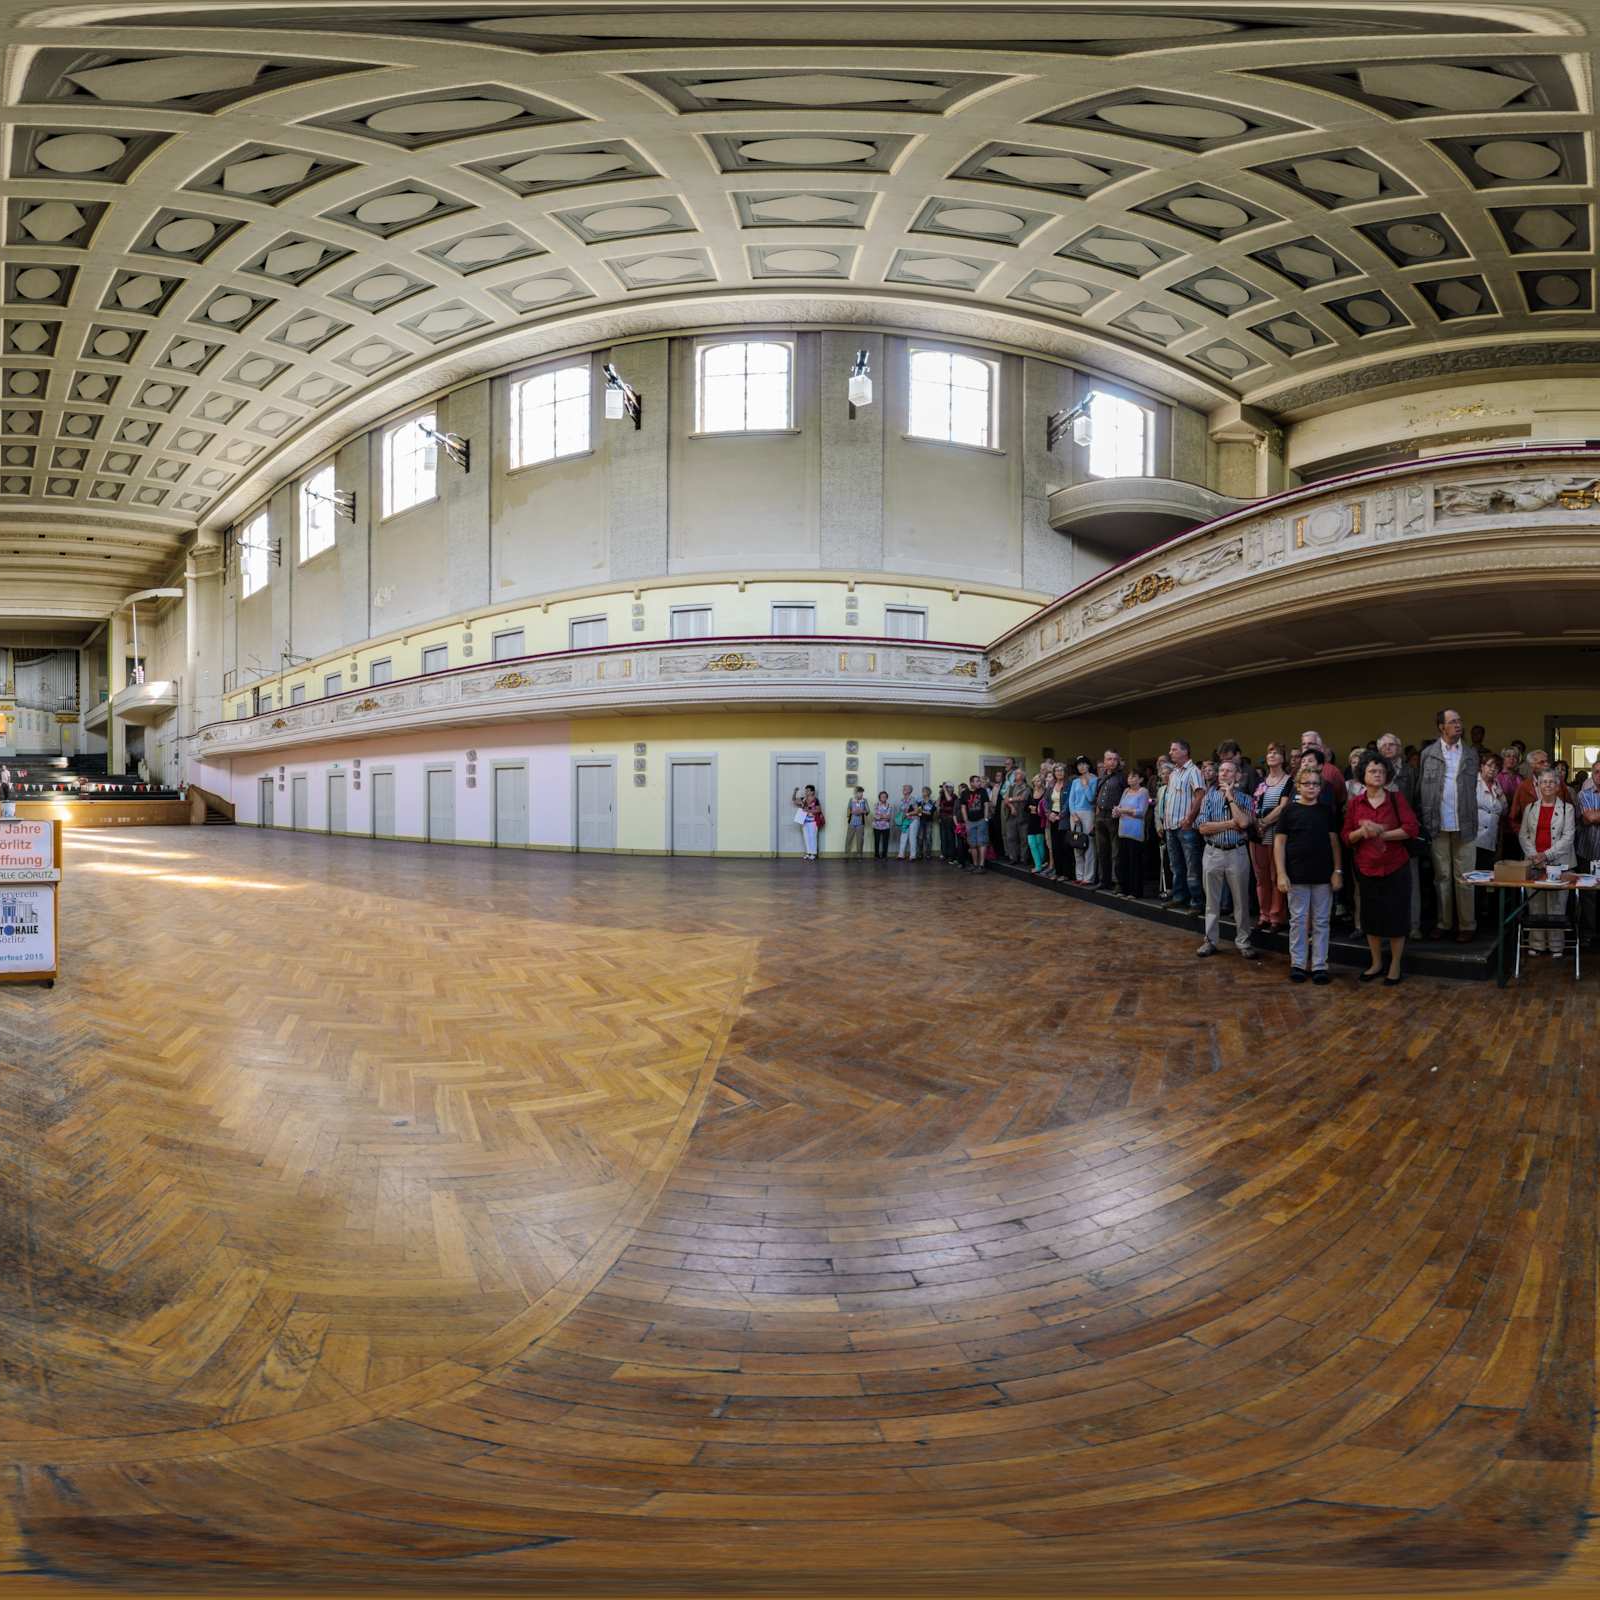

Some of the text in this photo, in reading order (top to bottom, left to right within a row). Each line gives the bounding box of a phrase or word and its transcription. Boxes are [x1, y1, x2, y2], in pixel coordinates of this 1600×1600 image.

[5, 823, 41, 834] Jahre
[18, 871, 54, 879] GÖRLITZ
[24, 953, 44, 961] 2015
